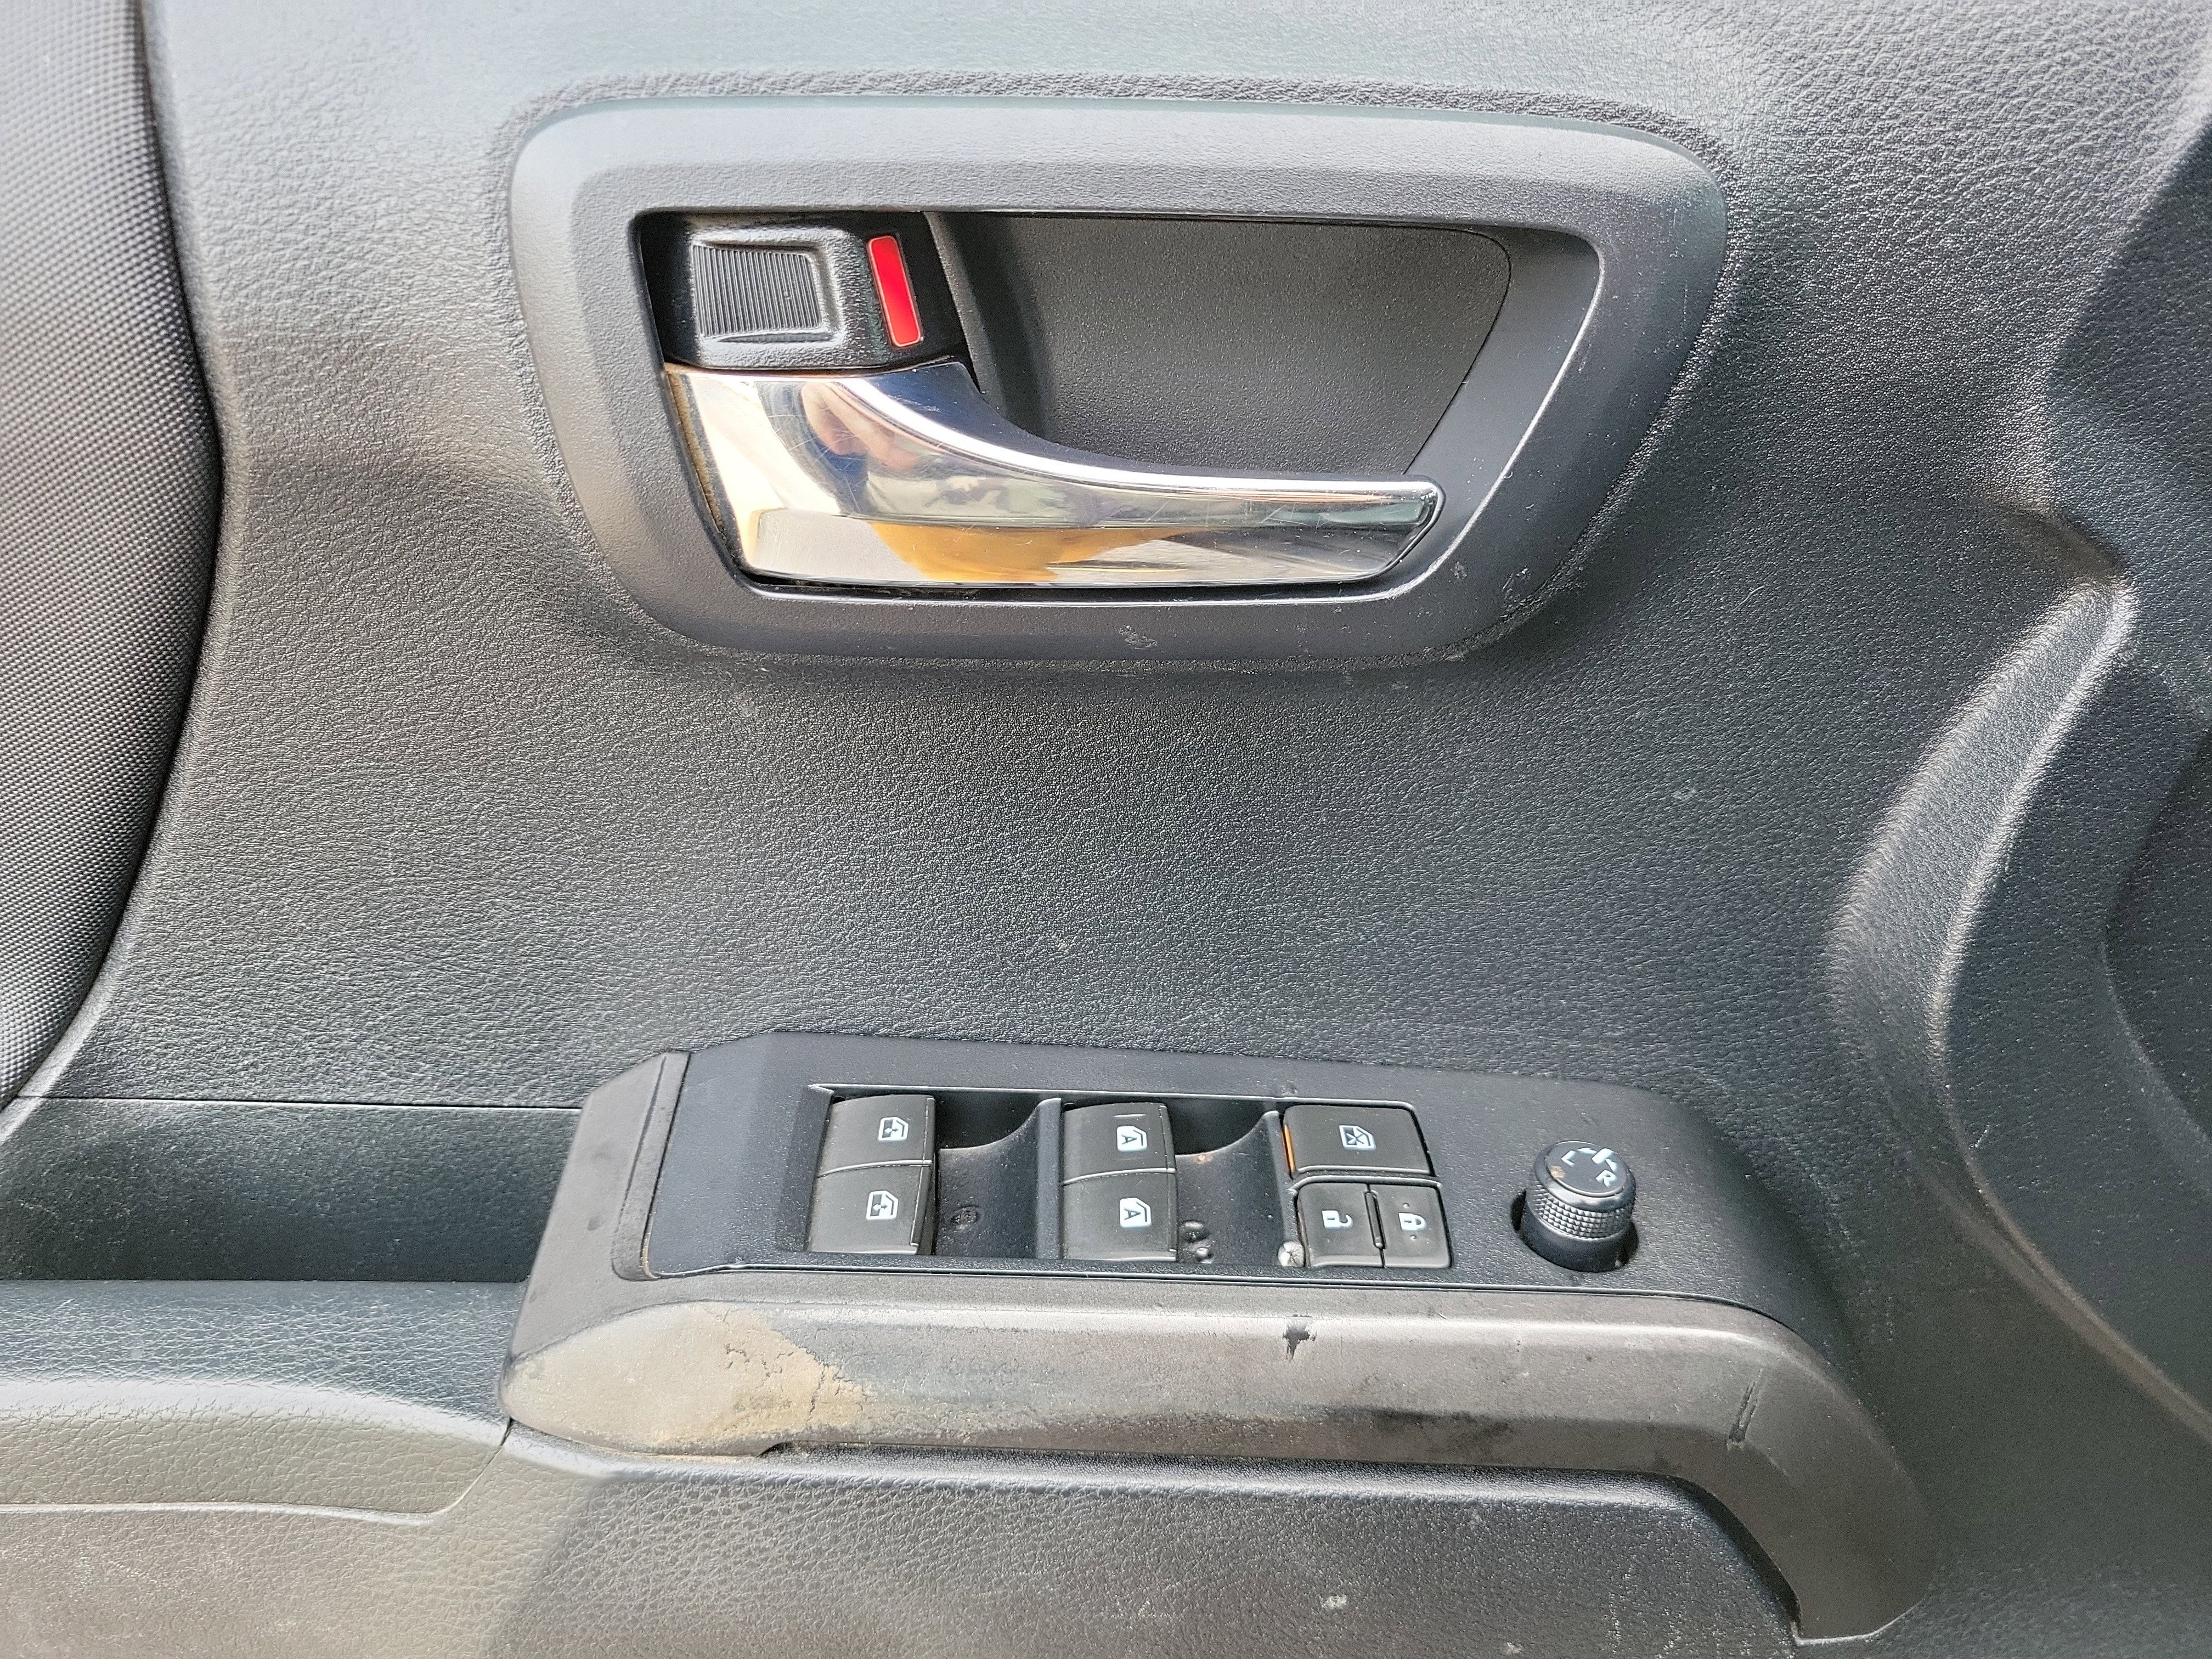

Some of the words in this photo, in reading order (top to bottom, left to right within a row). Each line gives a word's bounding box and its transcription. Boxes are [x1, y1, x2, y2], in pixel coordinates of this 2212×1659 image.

[1121, 1134, 1137, 1144] A
[1561, 1150, 1576, 1166] L
[1595, 1170, 1617, 1187] R
[1124, 1207, 1141, 1221] A
